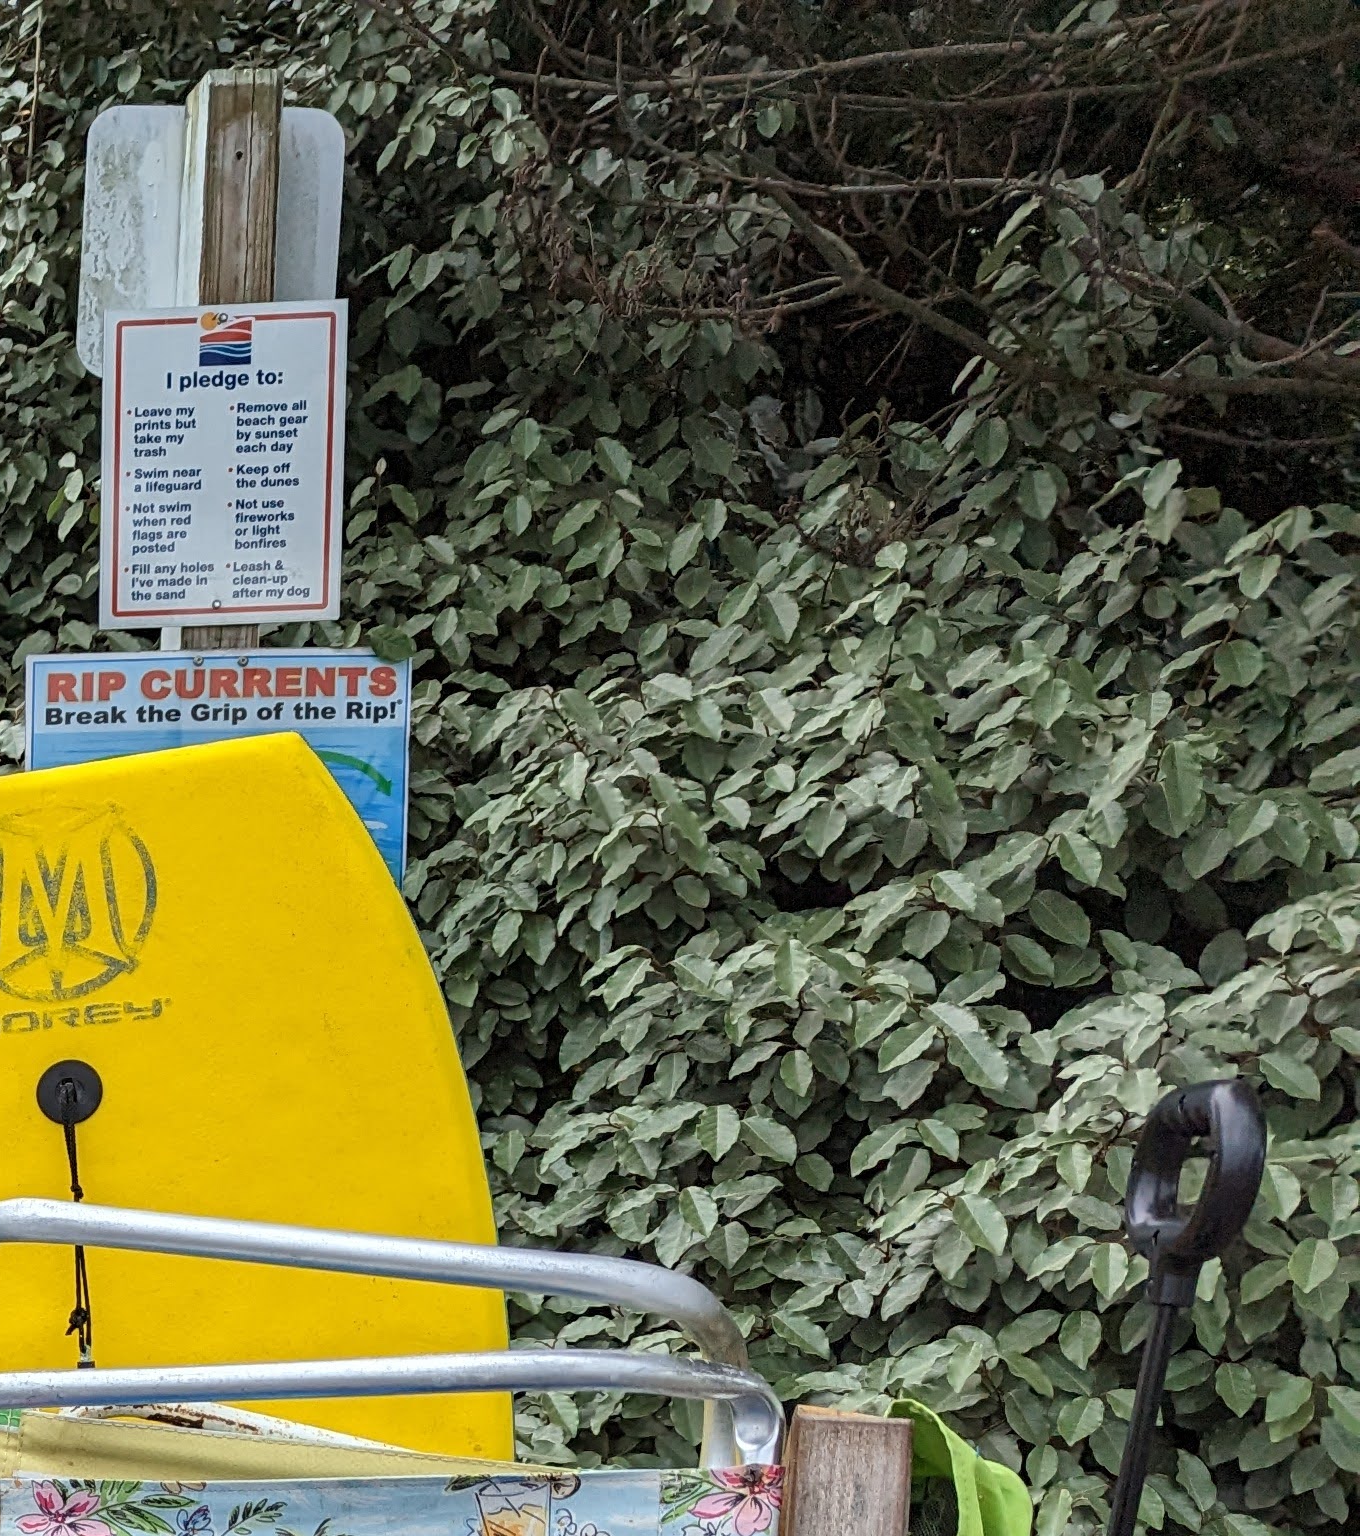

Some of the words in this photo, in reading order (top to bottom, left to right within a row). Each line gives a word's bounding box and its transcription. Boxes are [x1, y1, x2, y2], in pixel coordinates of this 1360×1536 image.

[167, 372, 173, 390] I
[180, 370, 249, 392] pledge
[256, 370, 283, 386] to:
[237, 400, 288, 413] Remove
[292, 399, 307, 411] all
[134, 406, 172, 418] Leave
[176, 406, 195, 420] my
[134, 419, 171, 433] prints
[176, 419, 196, 429] but
[236, 415, 275, 427] beach
[280, 414, 308, 427] gear
[134, 433, 161, 445] take
[166, 432, 184, 446] my
[236, 429, 251, 441] by
[255, 428, 298, 439] sunset
[134, 446, 167, 458] trash
[236, 442, 266, 454] each
[271, 441, 294, 454] day
[134, 467, 169, 480] Swim
[173, 467, 202, 478] near
[236, 464, 269, 477] Keep
[273, 463, 290, 474] off
[134, 482, 141, 492] a
[145, 480, 202, 494] lifeguard
[236, 477, 256, 488] the
[260, 476, 299, 488] dunes
[133, 502, 155, 514] Not
[159, 501, 192, 513] swim
[235, 499, 258, 510] Not
[262, 499, 285, 509] use
[133, 516, 167, 527] when
[171, 515, 191, 526] red
[235, 511, 295, 523] fireworks
[132, 529, 163, 542] flags
[167, 529, 187, 539] are
[235, 525, 249, 536] or
[253, 524, 280, 538] light
[132, 542, 175, 556] posted
[235, 538, 287, 550] bonfires
[132, 564, 151, 574] Fill
[154, 564, 177, 575] any
[180, 561, 214, 573] holes
[233, 560, 271, 572] Leash
[275, 560, 284, 570] &
[132, 576, 153, 587] I've
[157, 576, 192, 586] made
[196, 575, 207, 586] in
[232, 574, 288, 586] clean-up
[131, 590, 153, 601] the
[156, 589, 186, 600] sand
[232, 587, 262, 599] after
[266, 586, 284, 599] my
[287, 585, 310, 599] dog
[46, 672, 127, 702] RIP
[140, 666, 398, 700] CURRENTS
[45, 706, 127, 726] Break
[136, 703, 181, 723] the
[191, 702, 248, 726] Grip
[257, 701, 284, 720] of
[294, 700, 336, 720] the
[346, 701, 397, 724] Rip!
